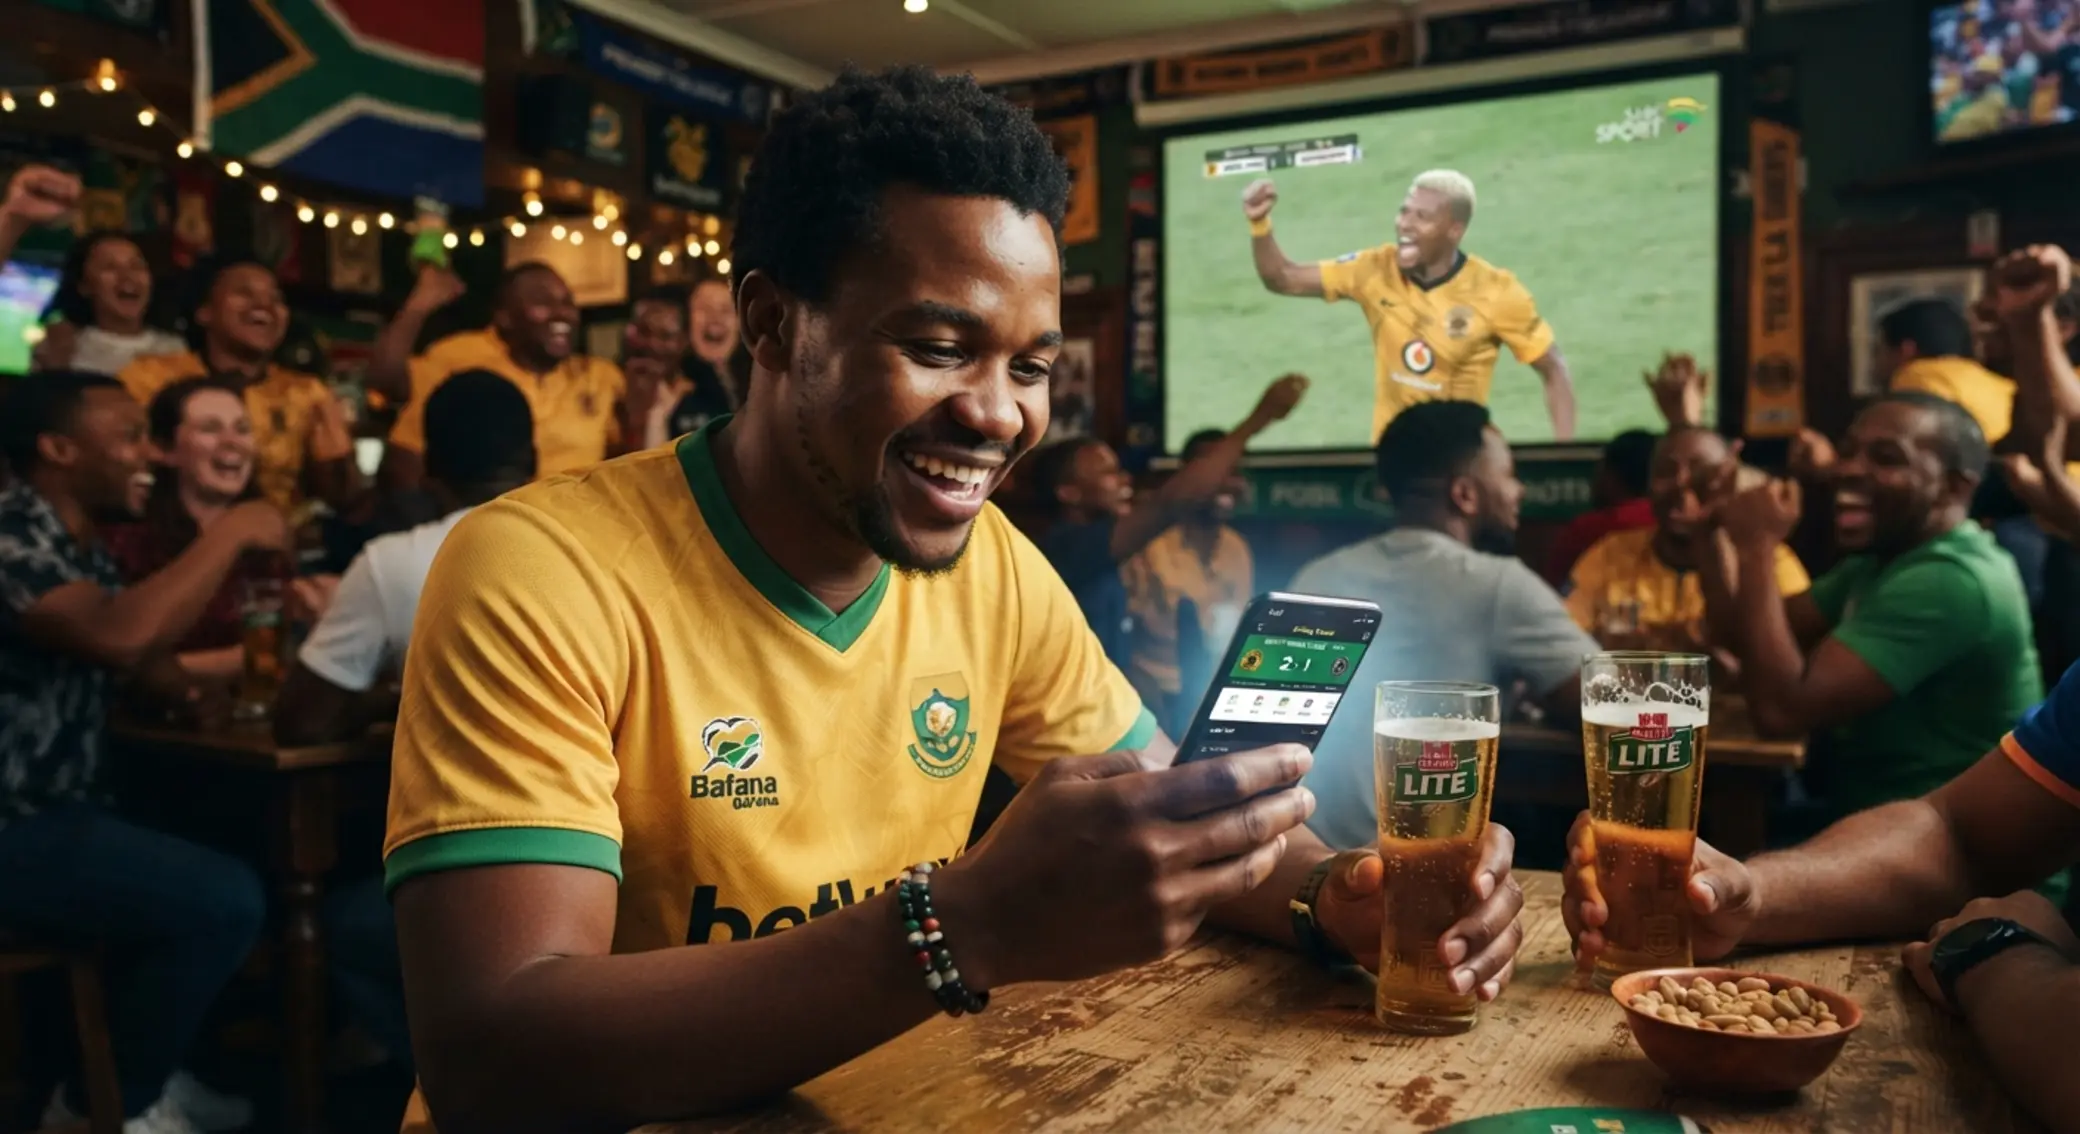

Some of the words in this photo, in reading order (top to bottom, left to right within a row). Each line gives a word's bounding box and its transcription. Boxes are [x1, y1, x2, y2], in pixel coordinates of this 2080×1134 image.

[1618, 740, 1682, 766] LITE
[690, 773, 777, 799] Bafana
[1403, 771, 1468, 796] LITE
